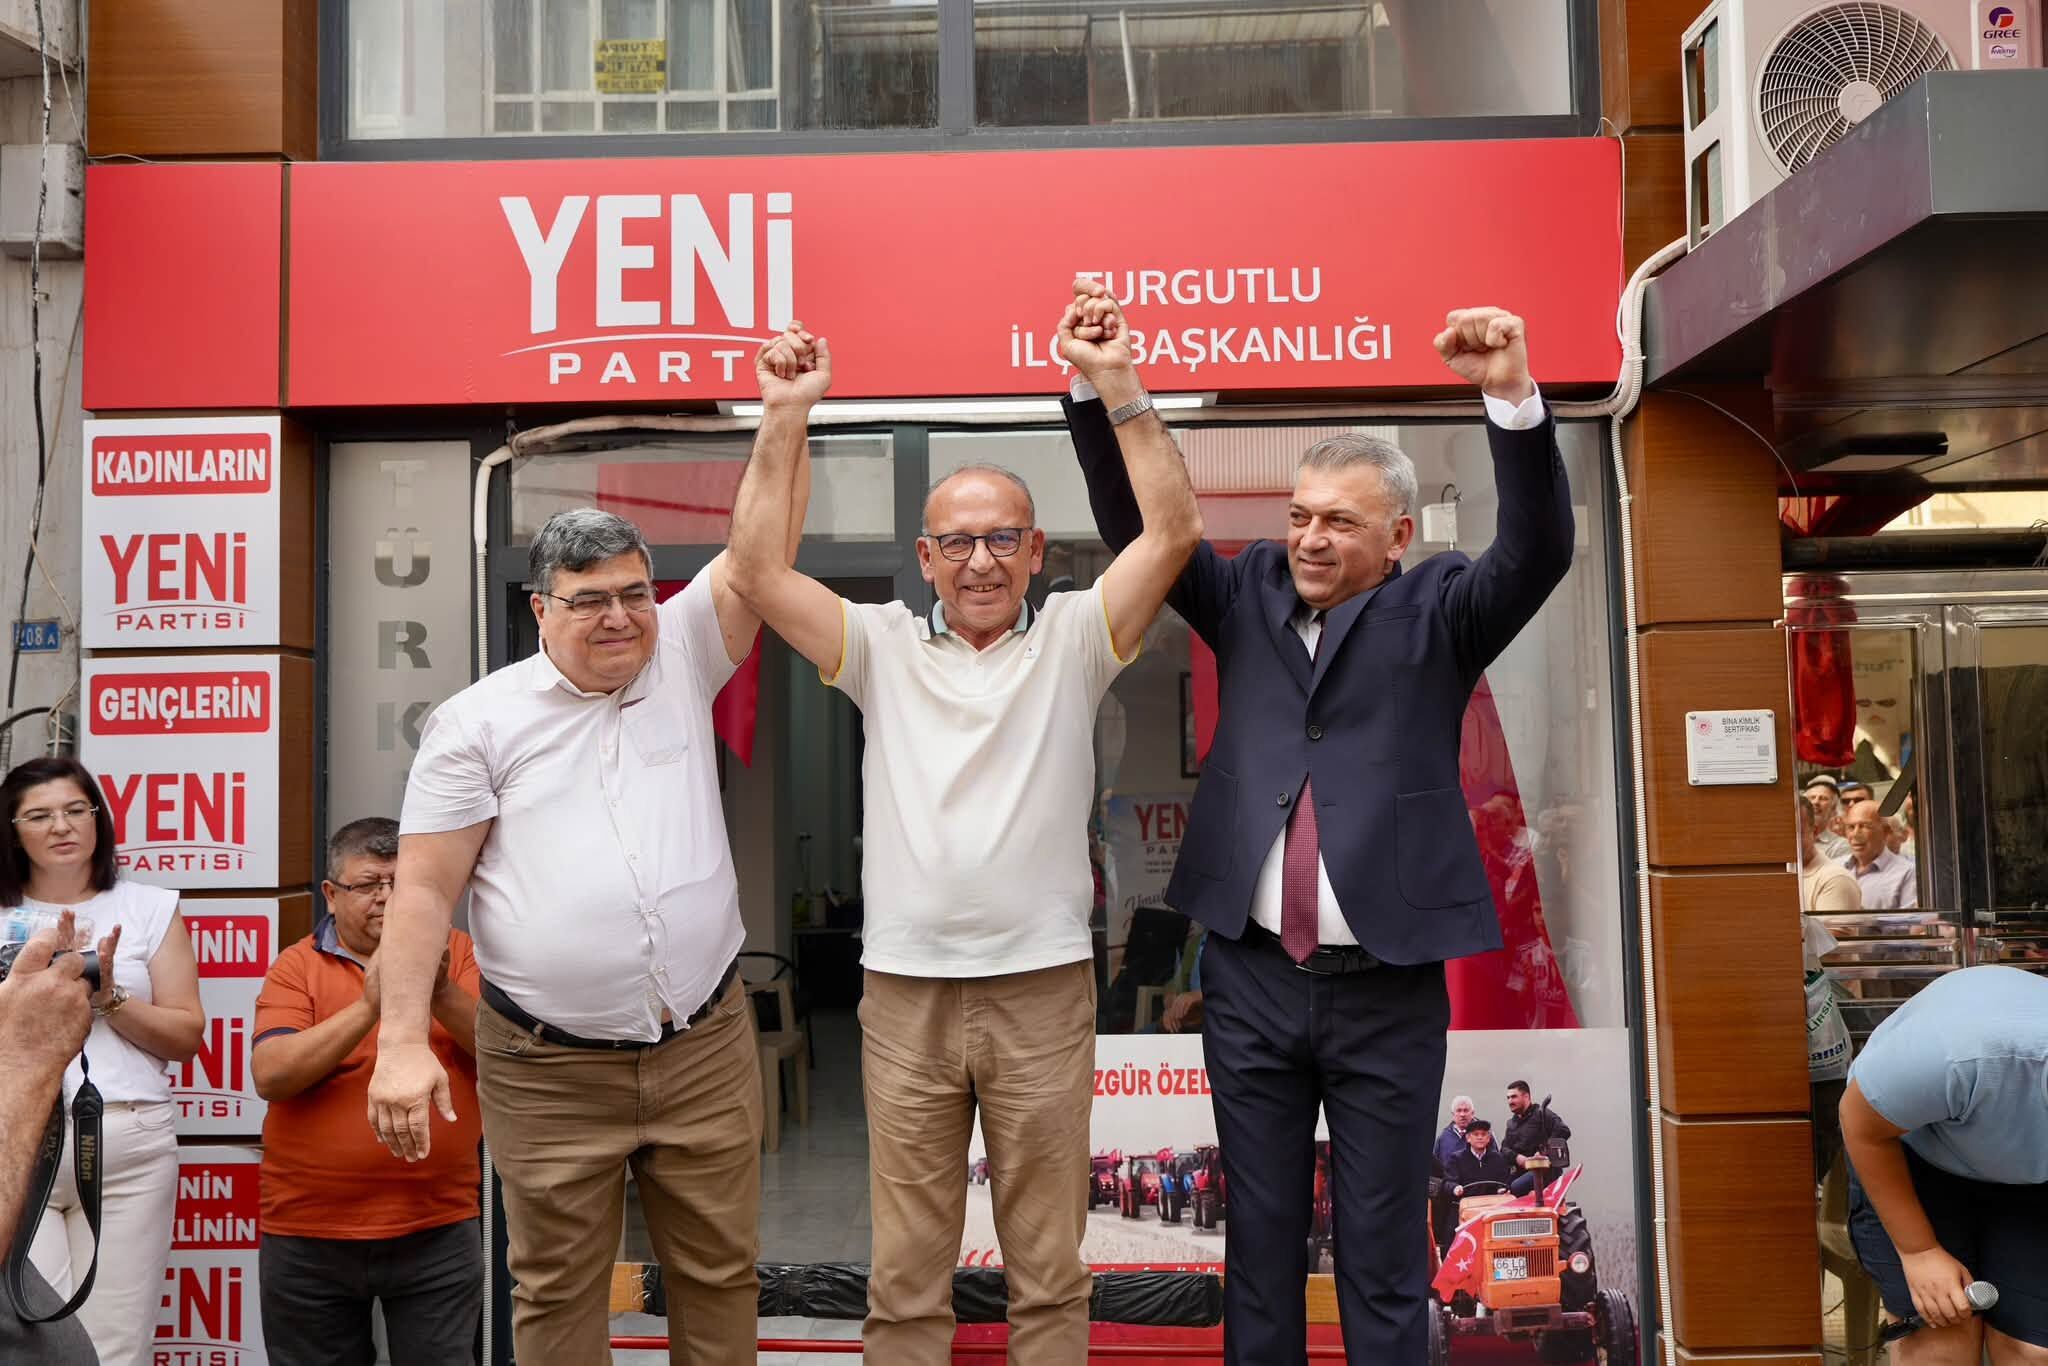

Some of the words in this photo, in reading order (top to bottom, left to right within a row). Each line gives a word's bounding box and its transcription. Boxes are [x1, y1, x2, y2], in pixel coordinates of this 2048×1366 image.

[1983, 29, 2022, 39] GREE
[1130, 315, 1392, 373] BAŞKANLIĞI
[96, 448, 266, 484] KADINLARIN
[99, 676, 262, 729] GENÇLERİN
[1093, 1062, 1153, 1096] ZGÜR
[1157, 1062, 1213, 1096] ÖZEL
[80, 1134, 96, 1181] Nikon
[179, 1169, 233, 1200] NİN
[172, 1212, 257, 1242] LİNİN
